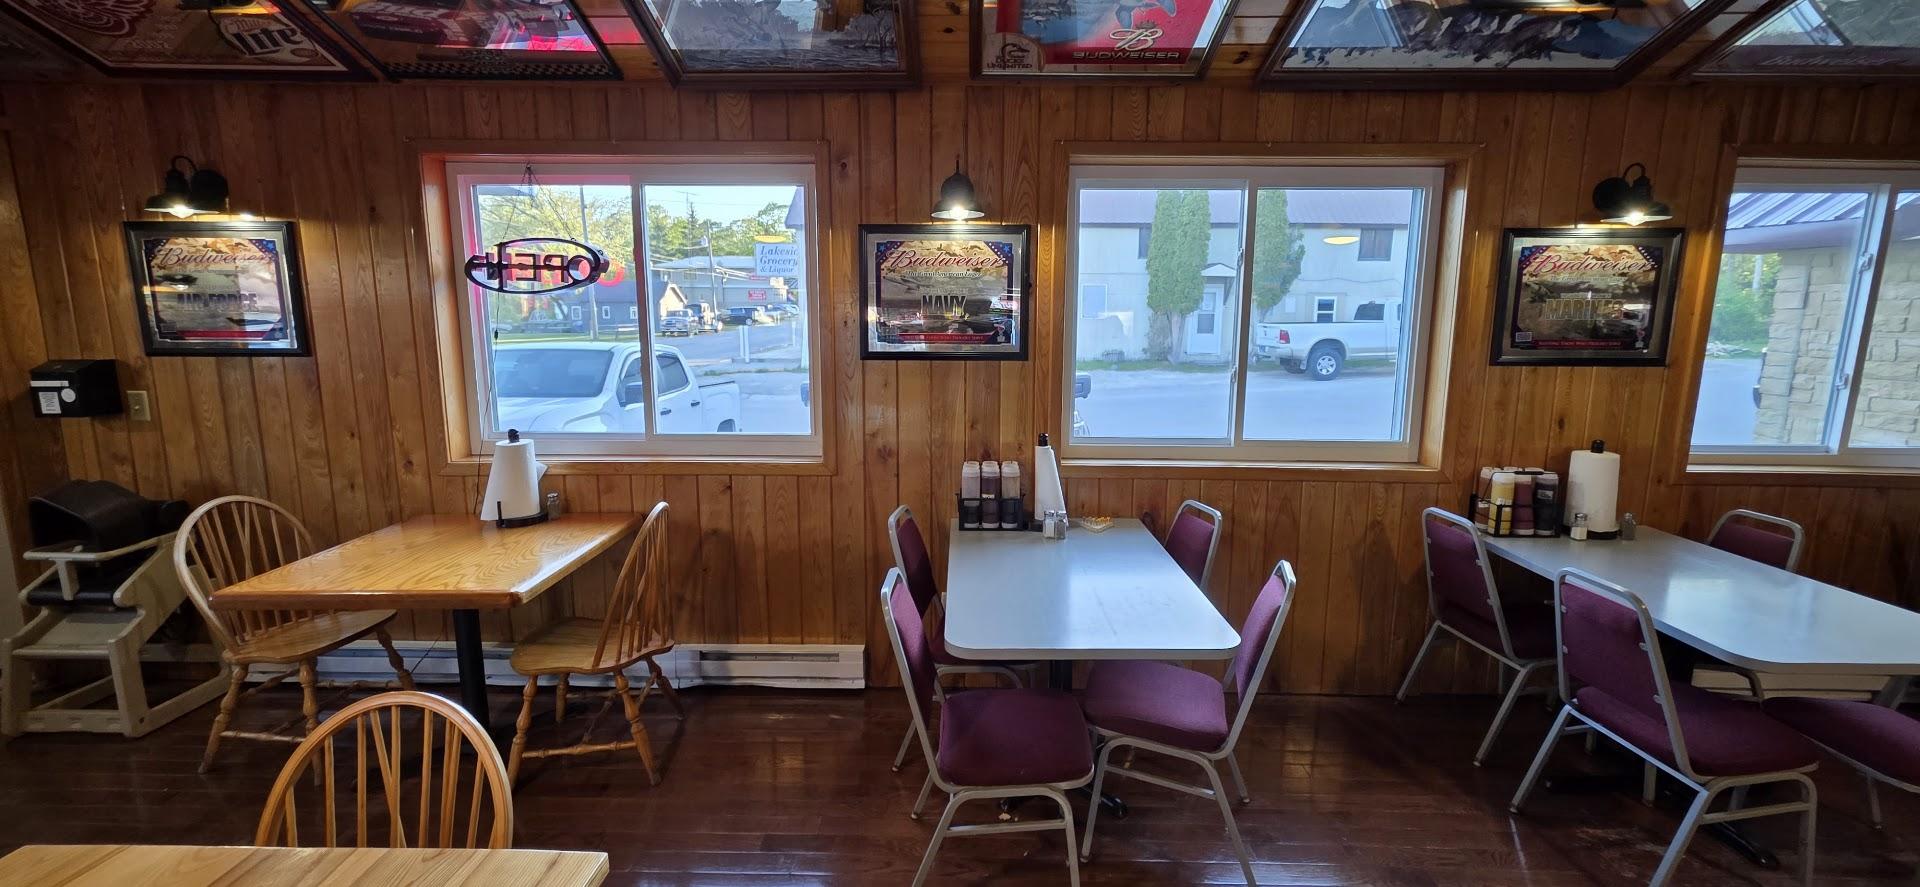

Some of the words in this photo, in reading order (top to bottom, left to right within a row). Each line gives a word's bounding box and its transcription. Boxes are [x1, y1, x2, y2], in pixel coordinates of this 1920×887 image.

[233, 27, 301, 56] Lite
[1072, 51, 1180, 60] BUDWEISER
[158, 247, 270, 265] Budweiser
[760, 245, 798, 256] Lakesi
[885, 250, 1004, 268] Budweiser
[760, 255, 798, 267] Grocery
[769, 265, 794, 275] Liquor
[1533, 254, 1654, 273] Budweiser
[920, 294, 967, 316] NAVY
[1545, 299, 1623, 320] MARINES
